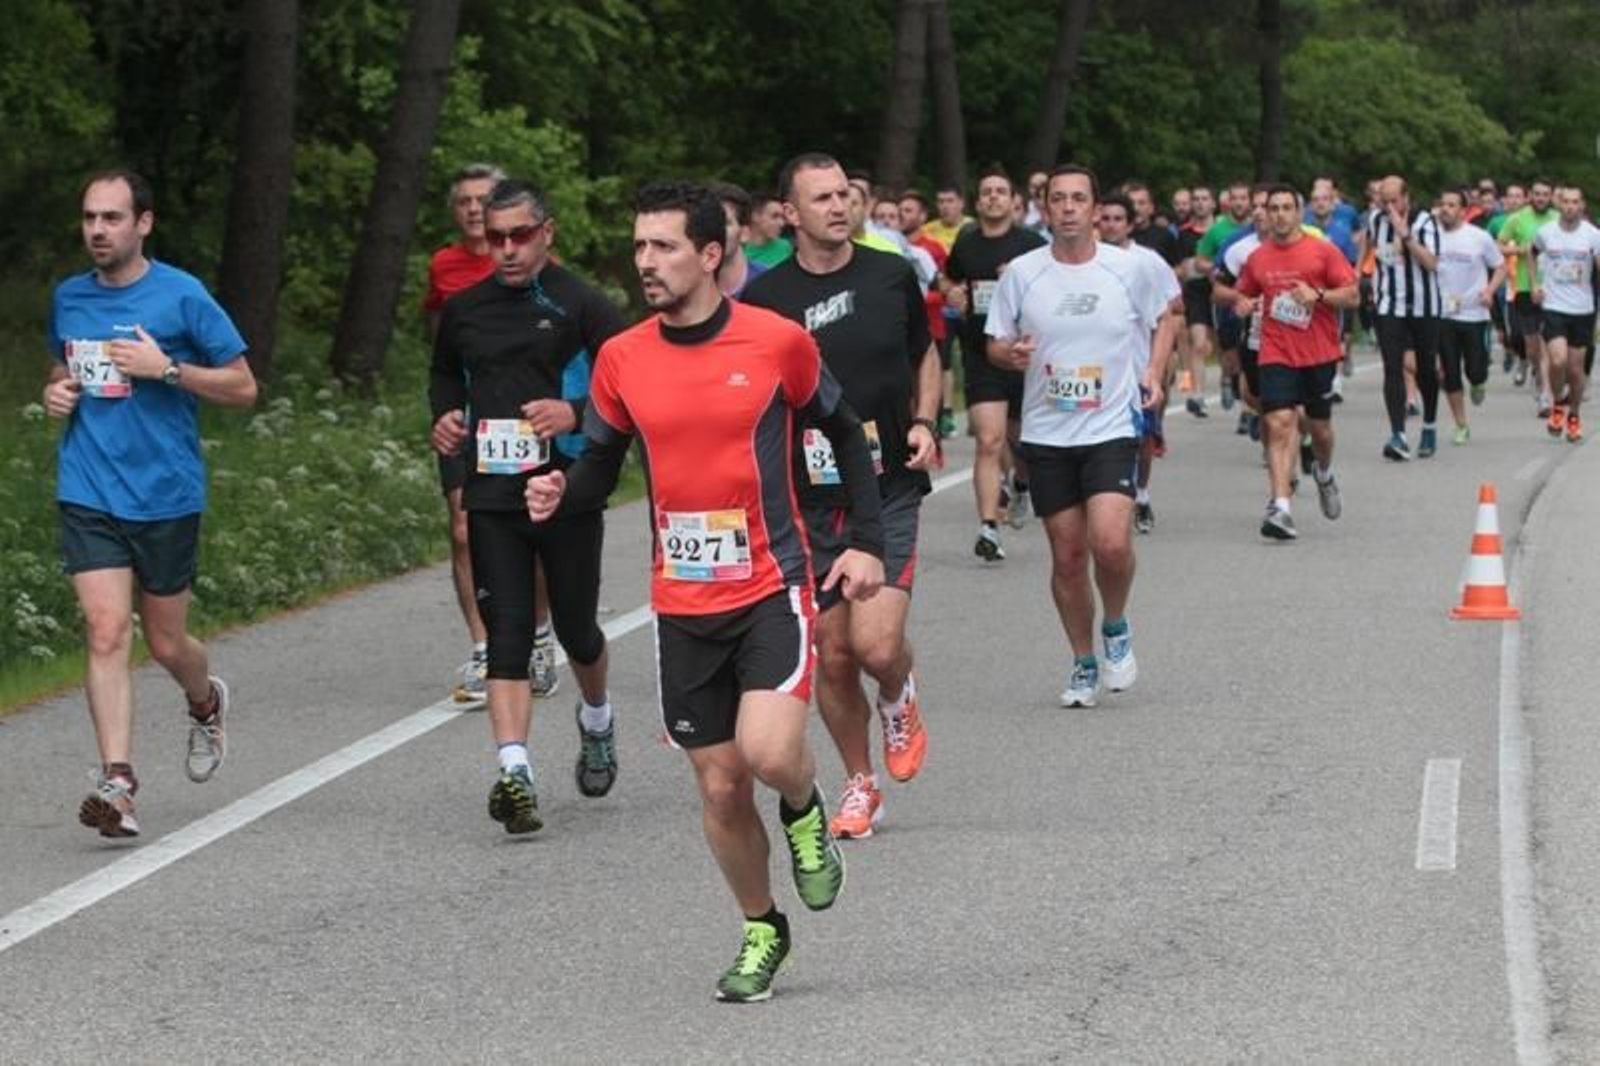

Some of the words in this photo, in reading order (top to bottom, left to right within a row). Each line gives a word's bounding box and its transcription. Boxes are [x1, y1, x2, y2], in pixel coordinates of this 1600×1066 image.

[1048, 379, 1088, 397] 320
[483, 439, 530, 459] 413
[667, 535, 722, 562] 227
